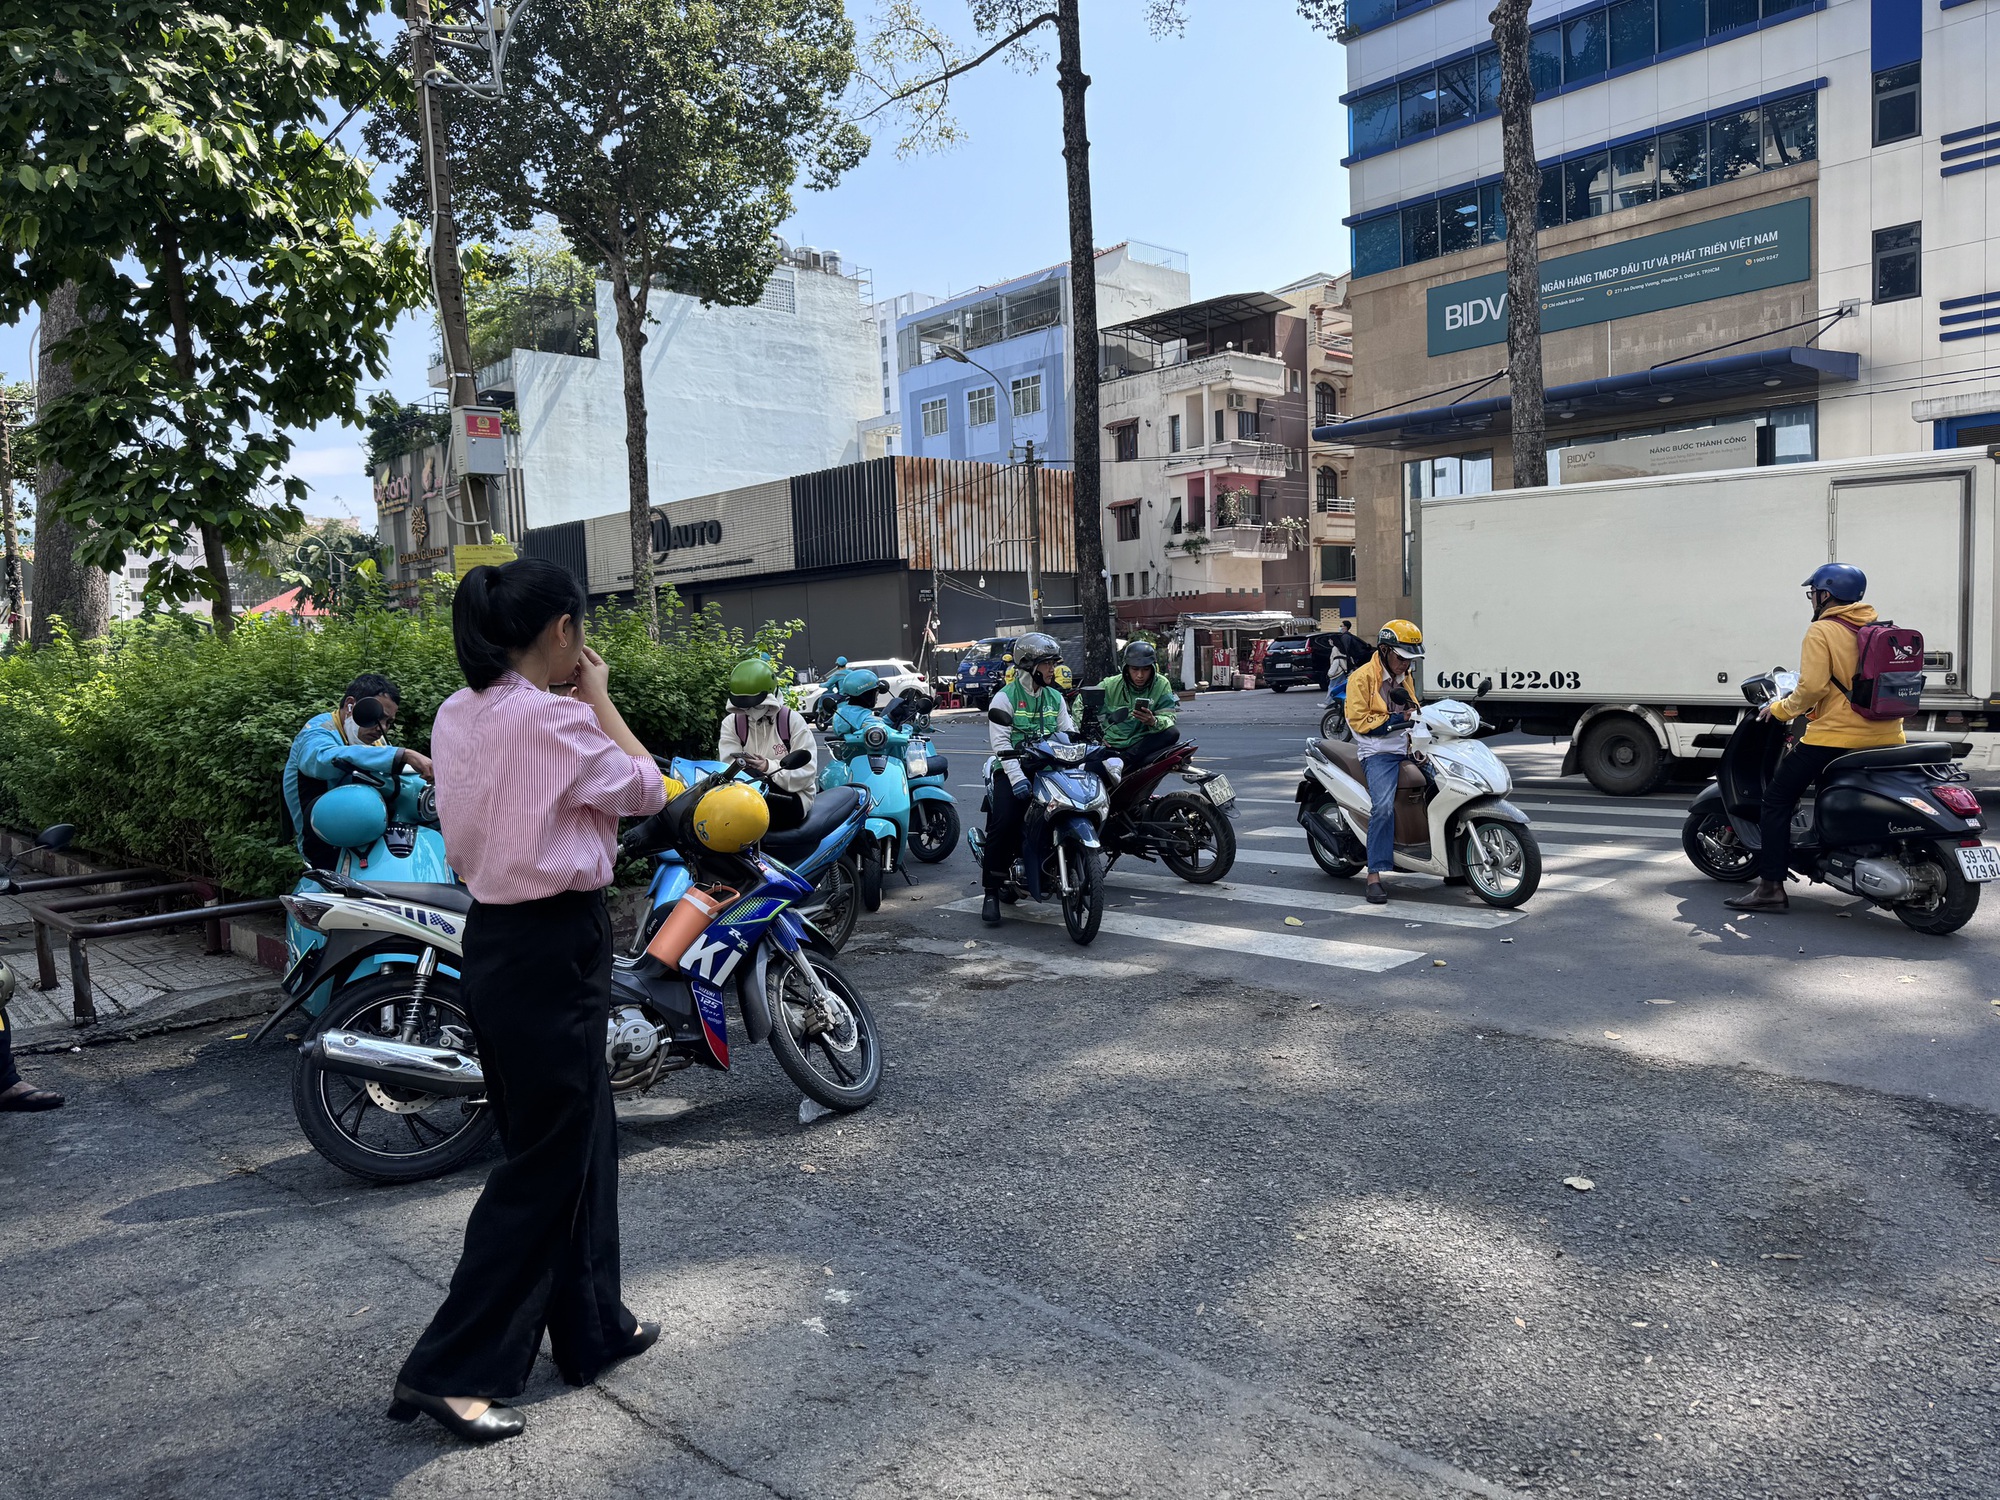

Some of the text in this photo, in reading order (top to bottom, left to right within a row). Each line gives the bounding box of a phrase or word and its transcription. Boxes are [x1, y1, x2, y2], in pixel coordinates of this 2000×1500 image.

[1541, 230, 1778, 293] NGÂN HÀNG TMCP ĐẦU TƯ VÀ PHÁT TRIỂN VIỆT NAM
[1765, 253, 1779, 261] 9247
[1445, 292, 1509, 331] BIDV
[1672, 442, 1694, 451] BƯỚC
[1695, 439, 1722, 449] THÀNH
[1724, 435, 1747, 445] CÔNG
[1567, 453, 1588, 464] BIDV
[670, 519, 722, 550] AUTO
[399, 551, 421, 565] GOLDEN
[1888, 821, 1926, 834] Vespa
[1962, 849, 1995, 864] 59-H2
[698, 985, 716, 998] SUZUKI
[700, 996, 720, 1009] 125
